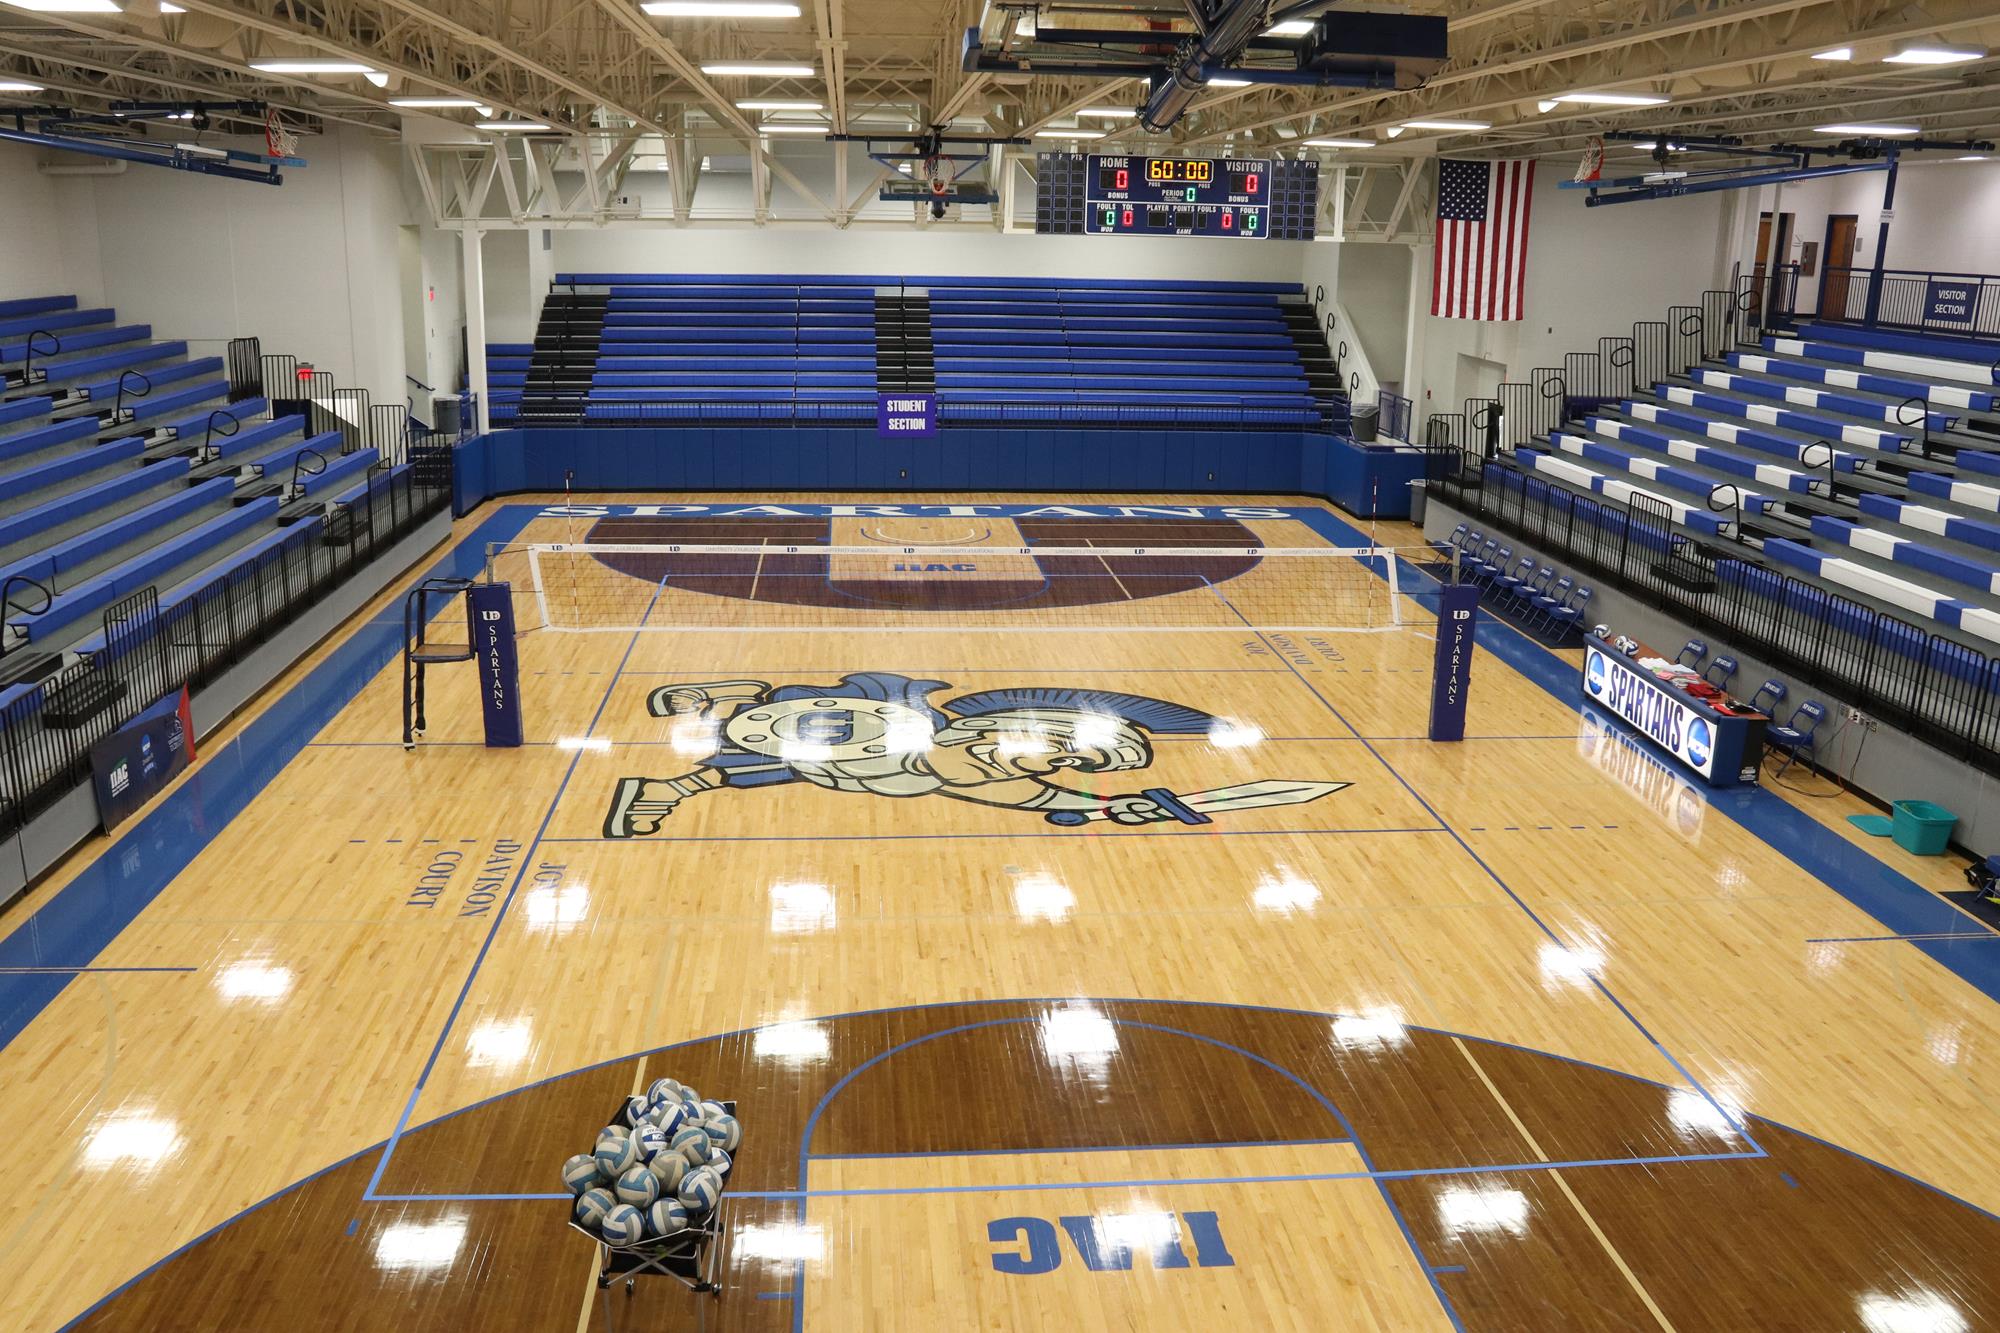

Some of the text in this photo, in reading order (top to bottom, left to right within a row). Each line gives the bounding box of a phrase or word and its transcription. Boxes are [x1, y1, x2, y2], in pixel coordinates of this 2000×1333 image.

[1100, 158, 1129, 168] HOME
[1151, 161, 1208, 179] 60:00
[1226, 162, 1263, 172] VISITOR
[1117, 170, 1128, 189] 0
[1246, 174, 1257, 193] 0
[1186, 188, 1196, 201] 0
[1106, 211, 1115, 225] 0
[1123, 211, 1133, 226] 0
[1222, 214, 1232, 229] 0
[1249, 215, 1257, 229] 0
[1938, 290, 1966, 300] VISITOR
[1934, 304, 1965, 315] SECTION
[887, 400, 927, 412] STUDENT
[888, 418, 926, 430] SECTION
[538, 504, 1292, 518] SPARTANS
[489, 625, 503, 709] SPARTANS
[1448, 624, 1463, 705] SPARTANS
[1609, 664, 1684, 753] SPARTANS
[110, 763, 129, 790] IIAC
[406, 851, 463, 909] COURT
[458, 843, 522, 918] DAVISON
